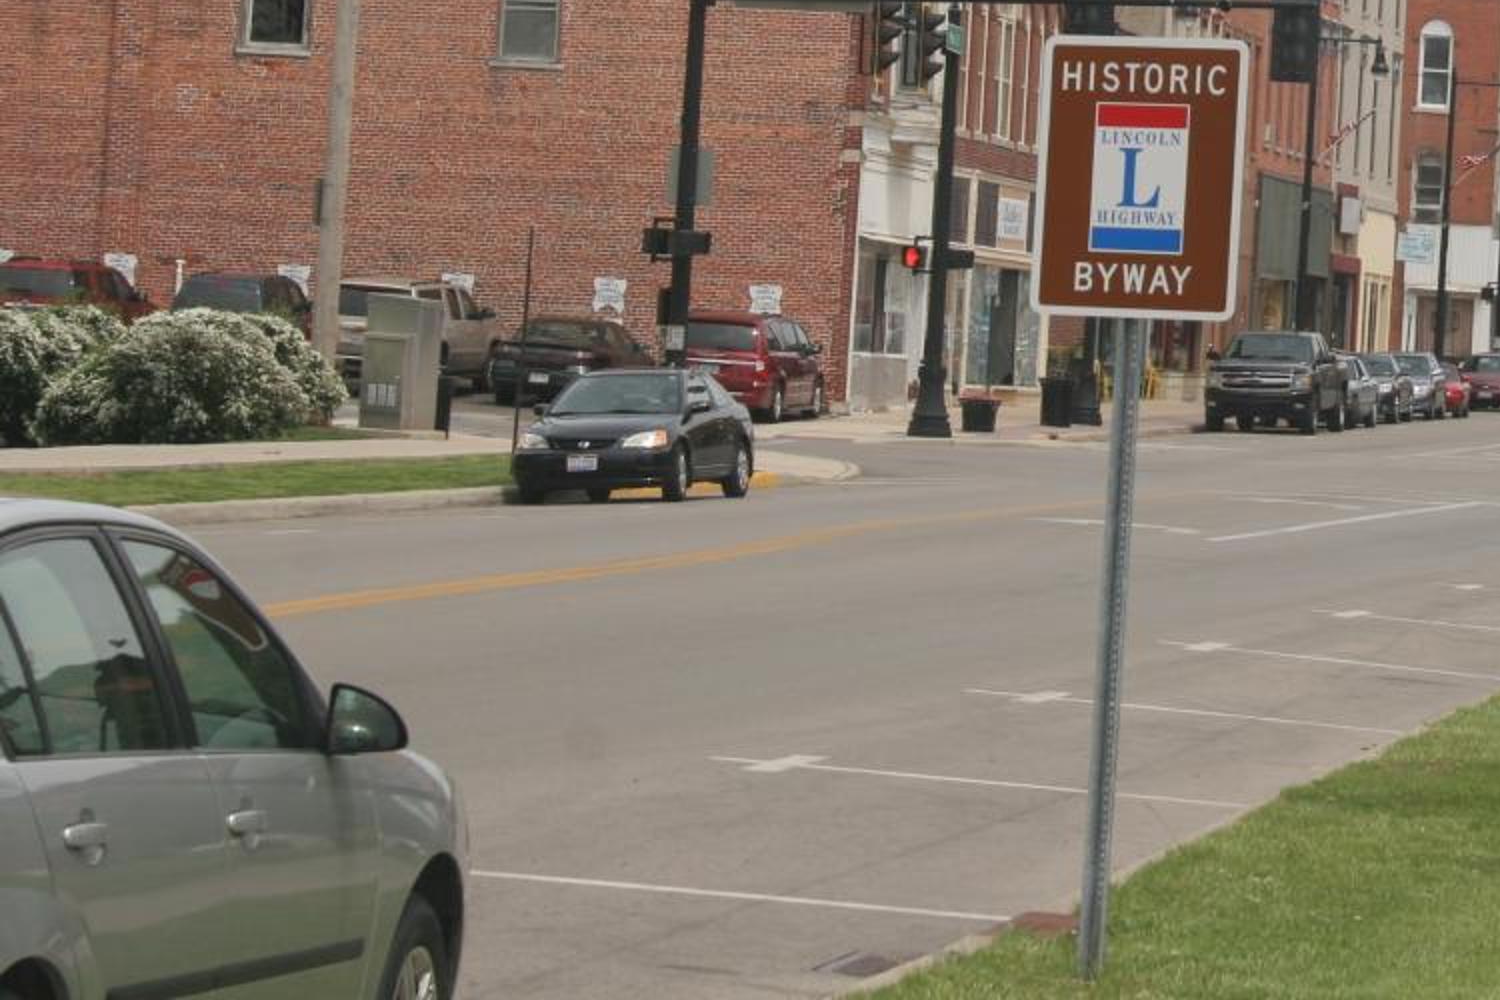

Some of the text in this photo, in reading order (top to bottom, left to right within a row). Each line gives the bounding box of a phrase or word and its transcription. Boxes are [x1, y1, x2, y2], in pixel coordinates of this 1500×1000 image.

[1062, 61, 1228, 96] HISTORIC
[1101, 130, 1182, 147] LINCOLN
[1117, 147, 1160, 208] L
[1097, 209, 1177, 225] HIGHWAY
[1073, 262, 1192, 295] BYWAY
